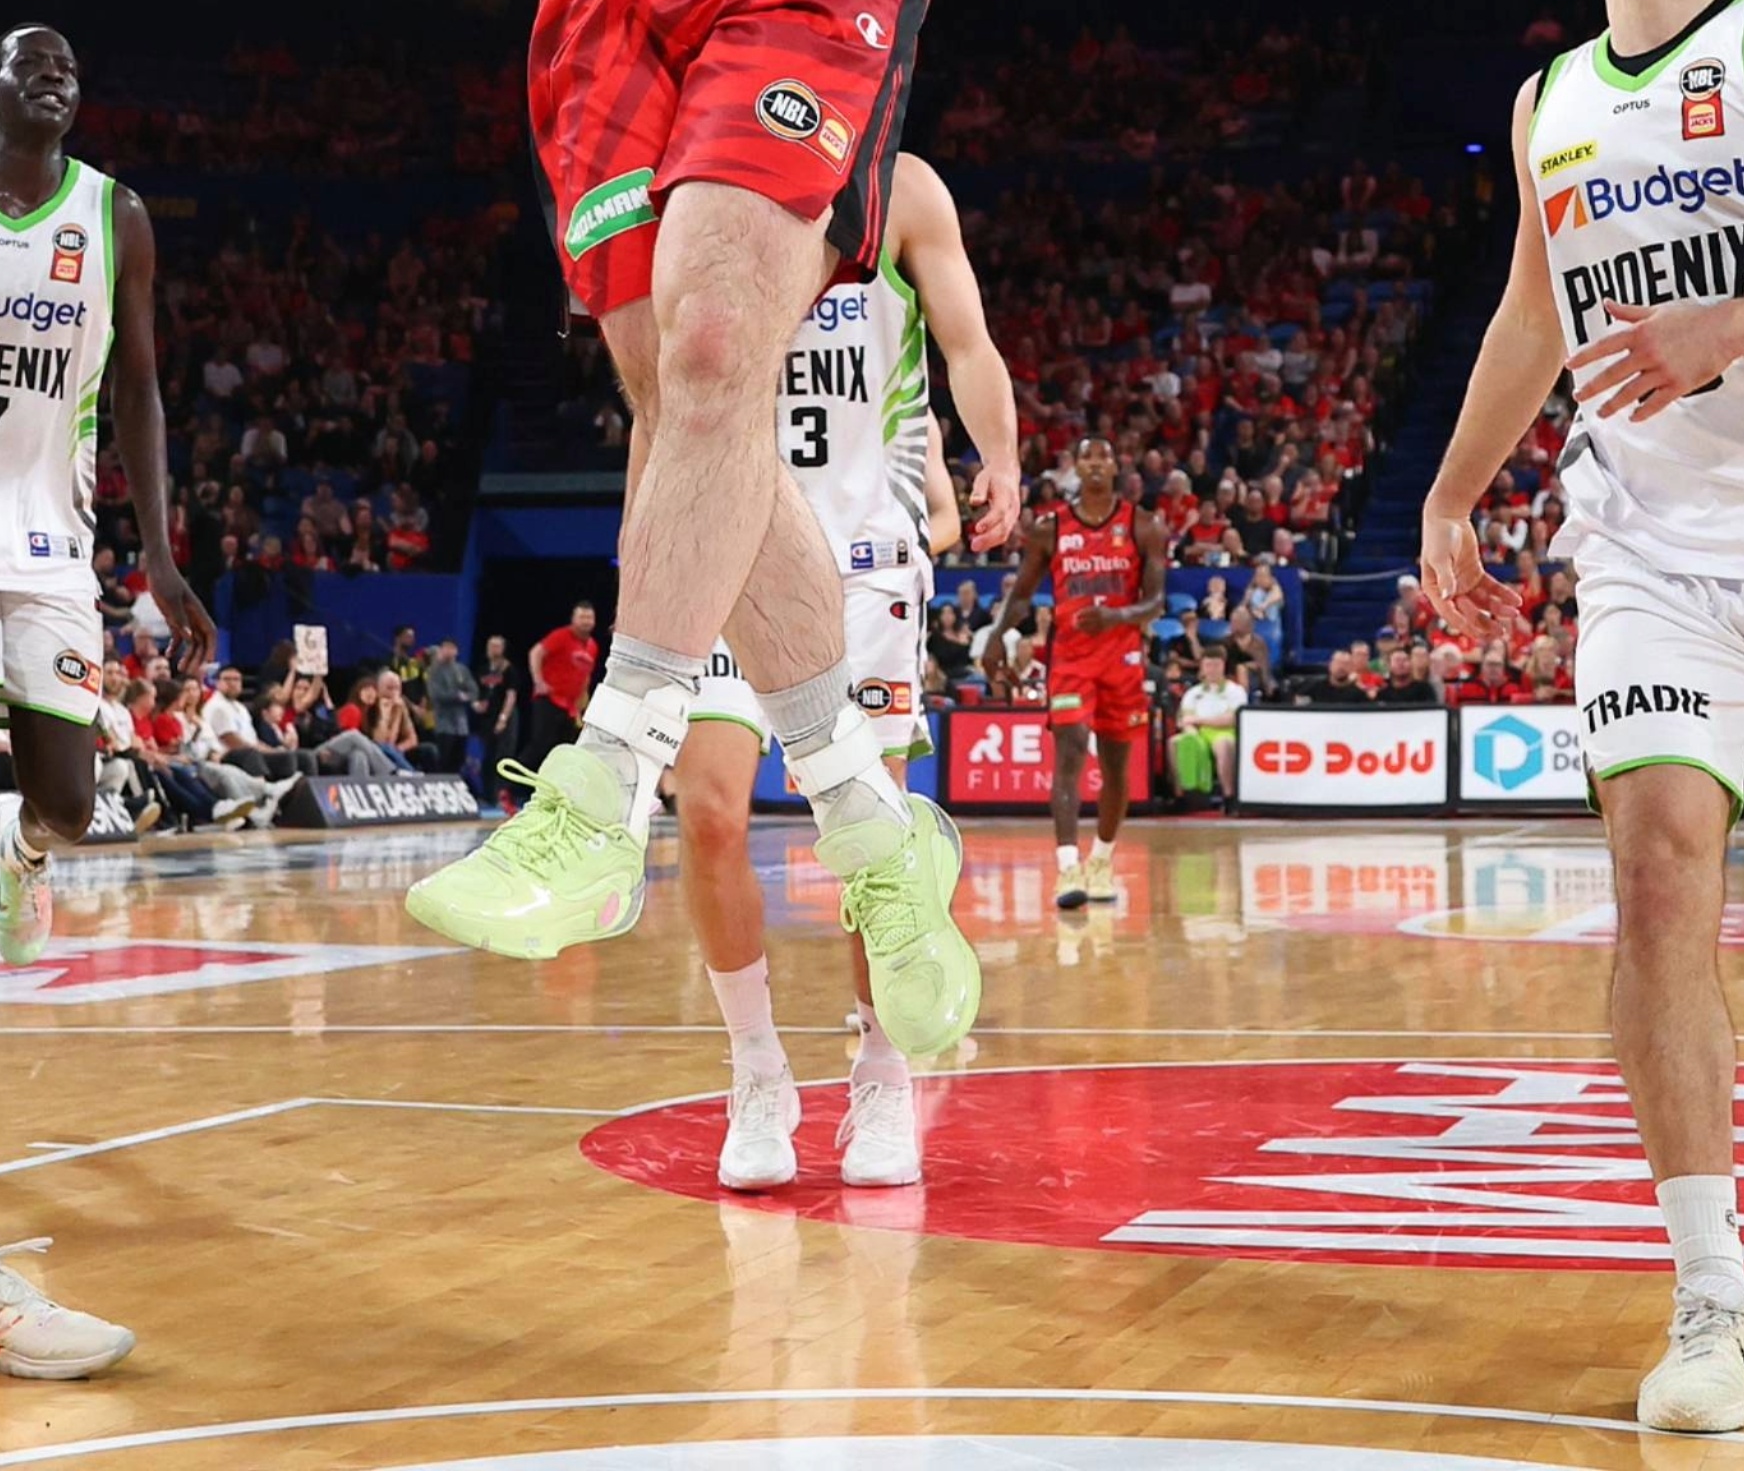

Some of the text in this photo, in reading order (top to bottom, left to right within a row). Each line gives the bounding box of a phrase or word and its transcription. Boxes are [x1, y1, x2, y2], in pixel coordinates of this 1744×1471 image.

[1688, 68, 1715, 90] NBL
[769, 92, 809, 127] NBL
[1613, 99, 1651, 115] OPTUS
[570, 184, 653, 244] HOLMAN
[803, 291, 868, 332] get
[780, 345, 868, 404] ENIX
[790, 406, 829, 468] 3
[862, 689, 891, 706] NBL
[1583, 684, 1711, 735] TRADIE
[1325, 740, 1435, 775] Dodd
[967, 769, 1104, 791] FITNS
[338, 782, 378, 820] ALL
